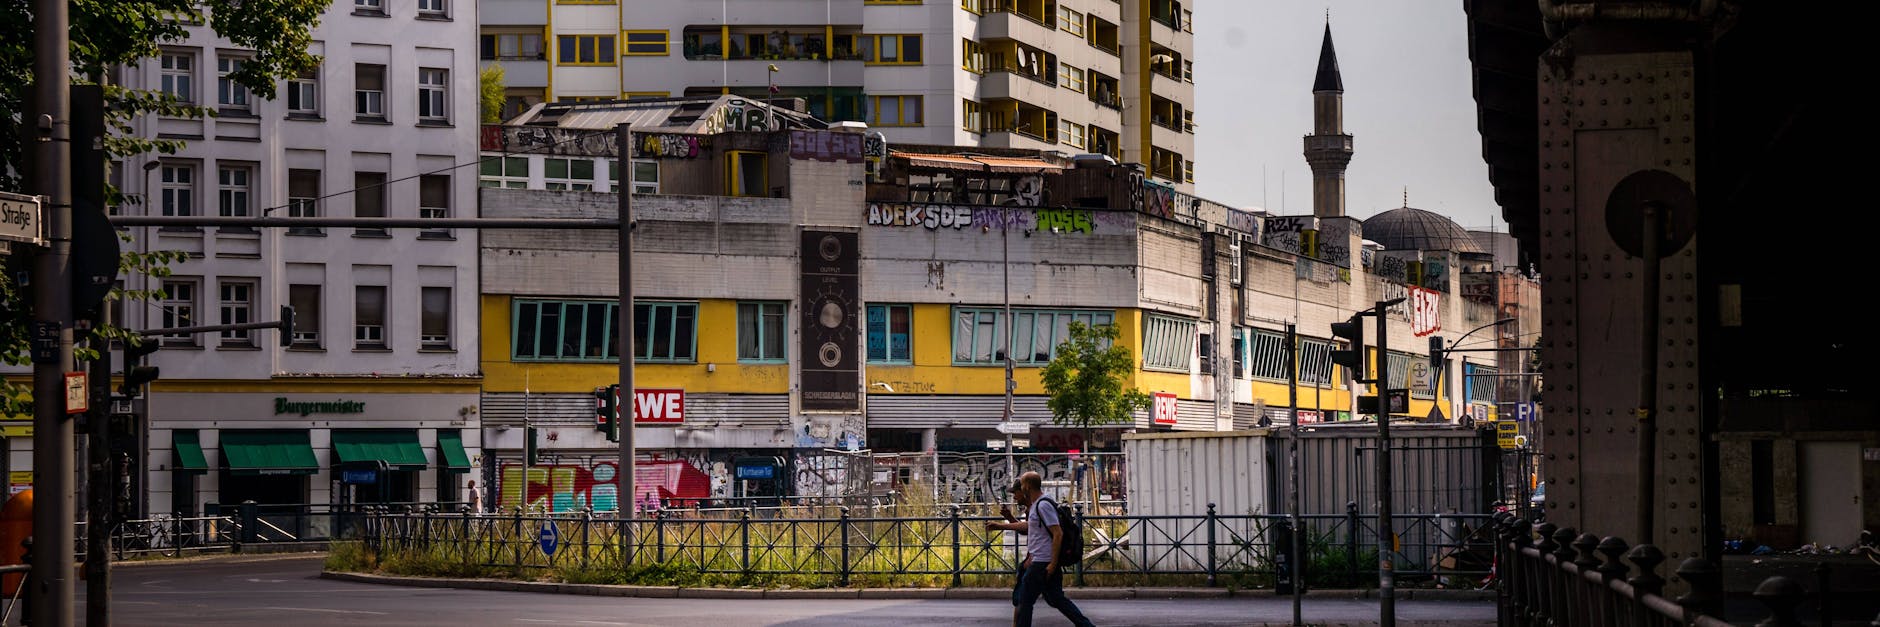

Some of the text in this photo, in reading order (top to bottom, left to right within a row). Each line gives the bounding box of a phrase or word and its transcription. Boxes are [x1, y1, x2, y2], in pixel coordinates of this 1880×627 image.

[2, 202, 30, 230] Straße
[868, 203, 922, 226] ADEK
[1266, 218, 1303, 233] RZK
[275, 397, 365, 416] Burgermeister
[1155, 397, 1177, 420] REWE
[1518, 403, 1532, 420] P
